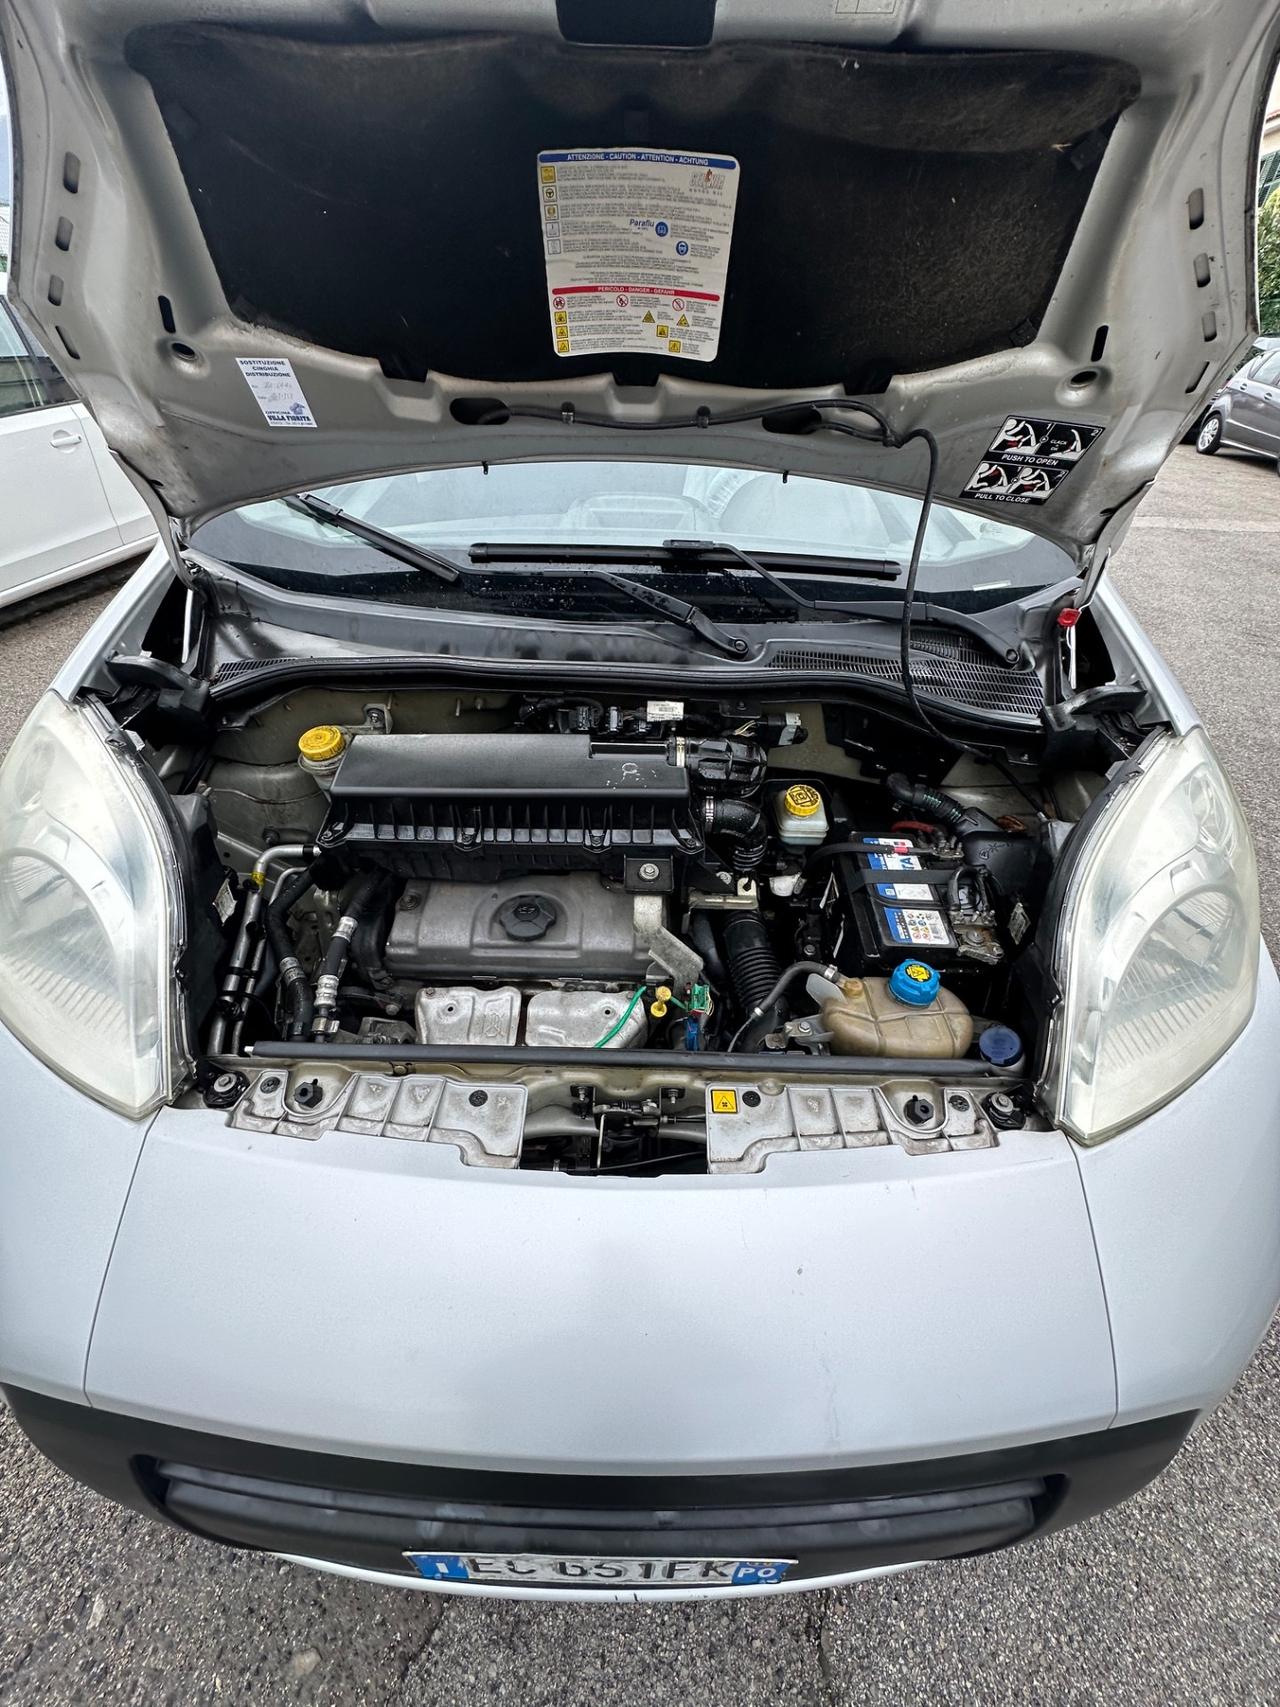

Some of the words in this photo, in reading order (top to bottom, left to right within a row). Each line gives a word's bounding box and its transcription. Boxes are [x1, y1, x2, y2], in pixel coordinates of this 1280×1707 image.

[609, 152, 637, 160] CAUTION
[641, 153, 675, 163] ATTENTION
[679, 155, 709, 166] ACHTUNG
[1001, 453, 1024, 462] PUSH
[1036, 457, 1059, 466] OPEN
[974, 492, 993, 500] PULL
[1005, 495, 1031, 504] CLOSE
[738, 1567, 777, 1578] PO
